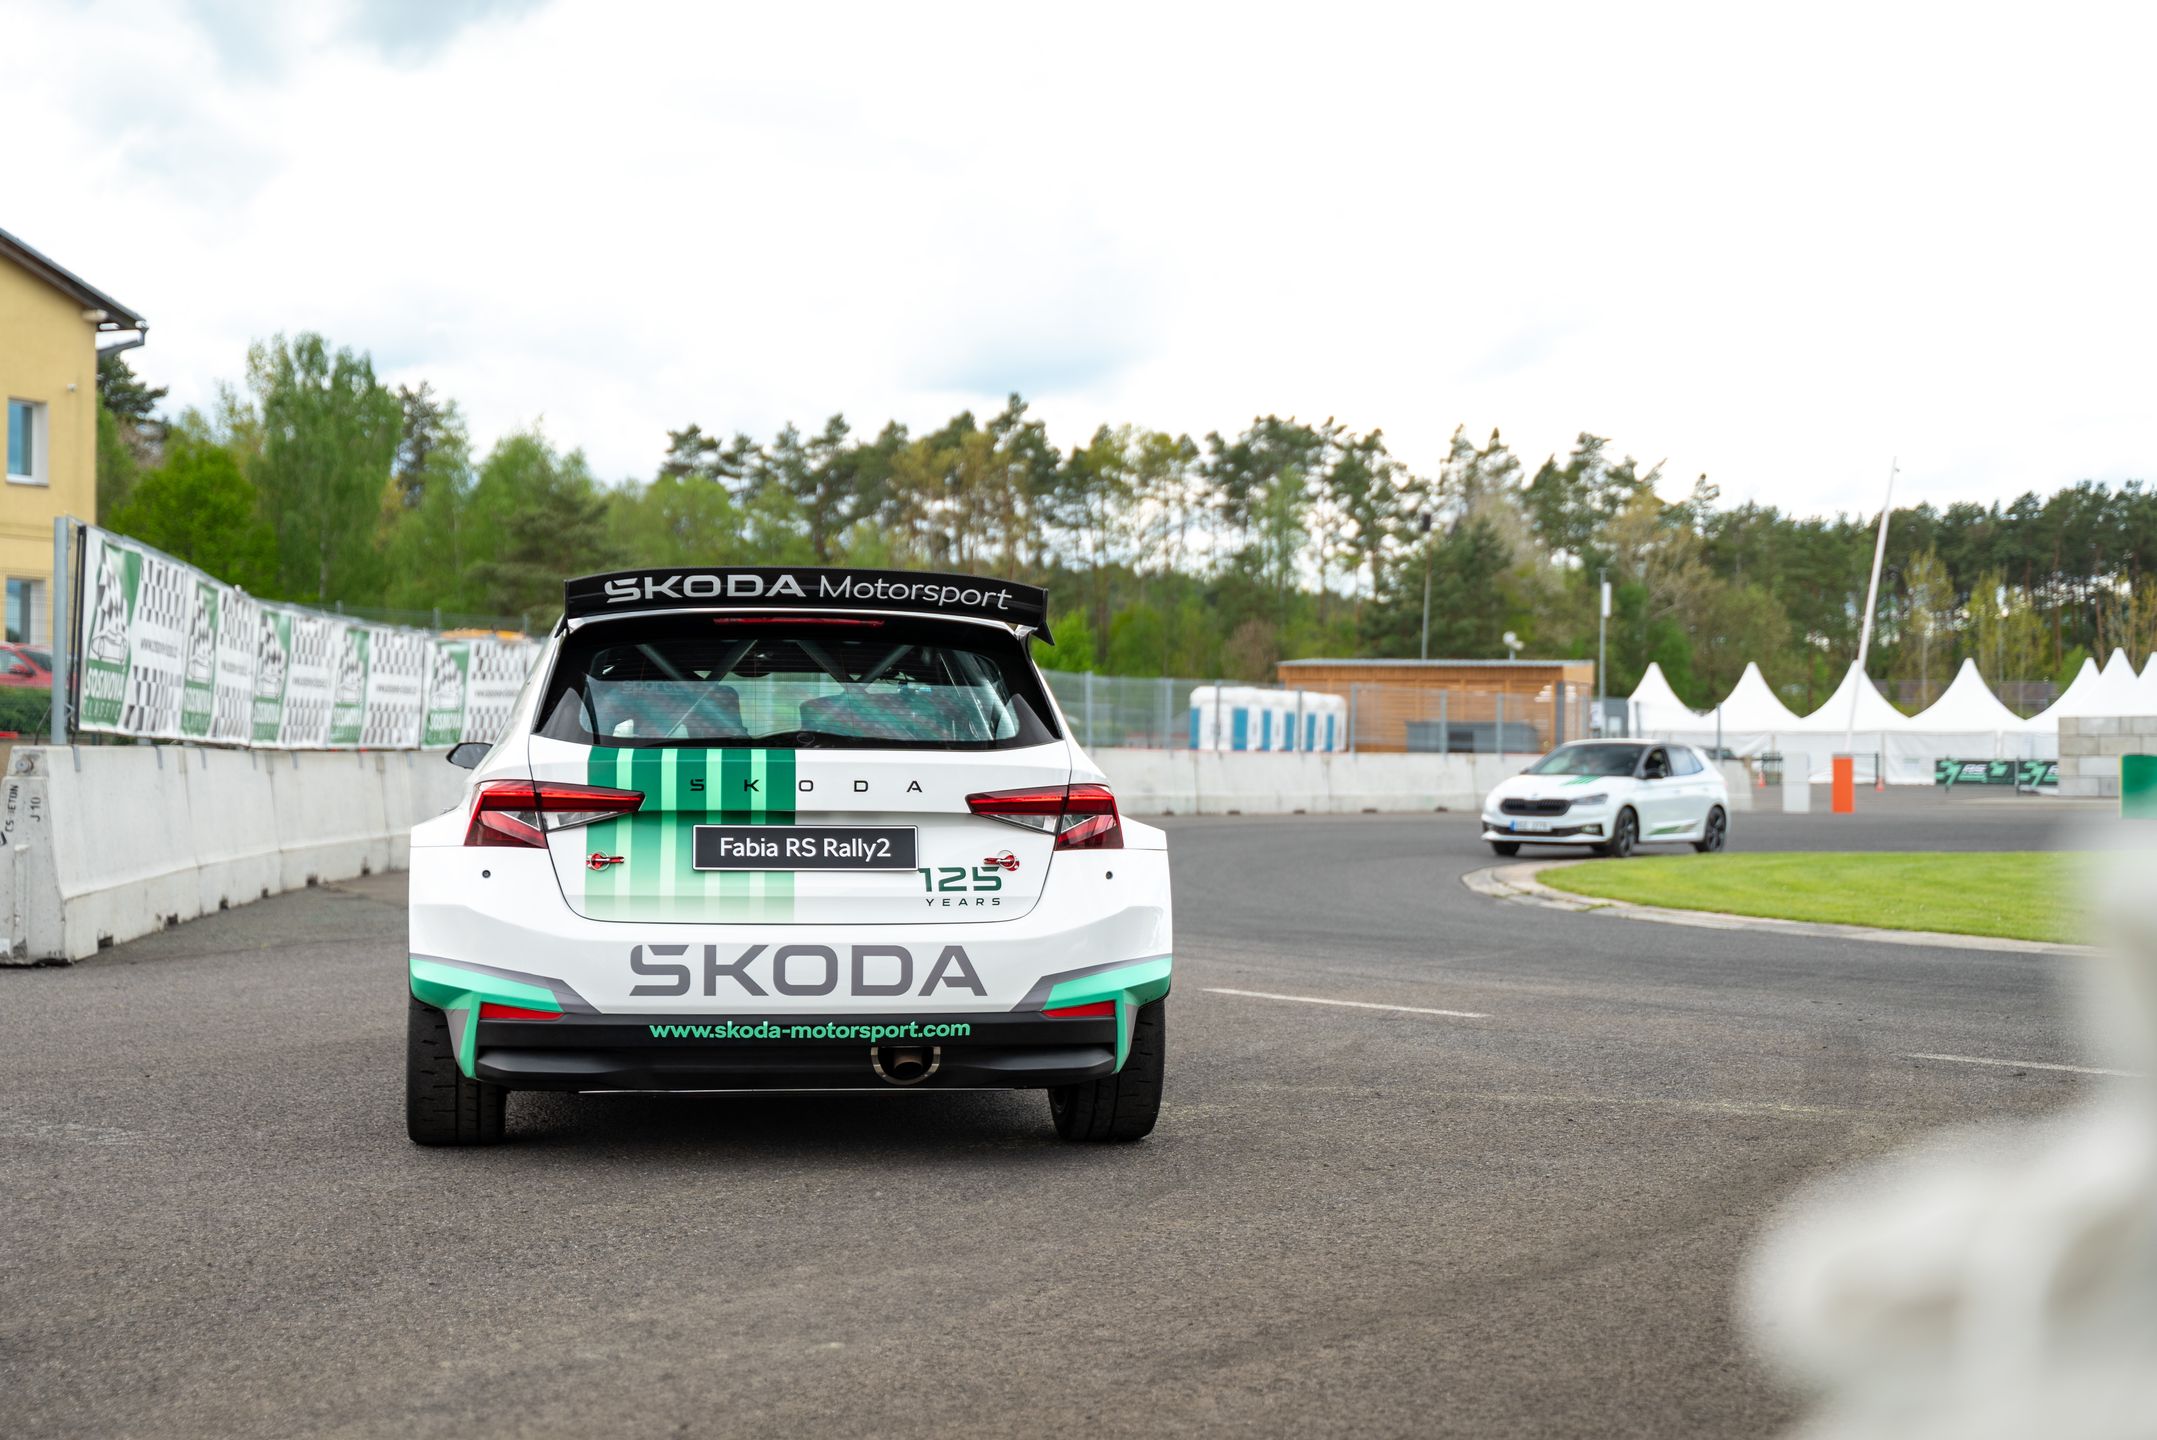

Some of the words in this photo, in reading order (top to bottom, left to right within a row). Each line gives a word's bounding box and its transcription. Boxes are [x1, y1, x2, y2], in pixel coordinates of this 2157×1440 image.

[819, 575, 1013, 611] Motorsport
[720, 837, 779, 858] Fabia
[786, 837, 817, 858] RS
[823, 837, 892, 863] Rally2
[919, 866, 1003, 893] 125
[925, 898, 1001, 907] YEARS
[649, 1020, 971, 1043] www.skoda-motorsport.com
